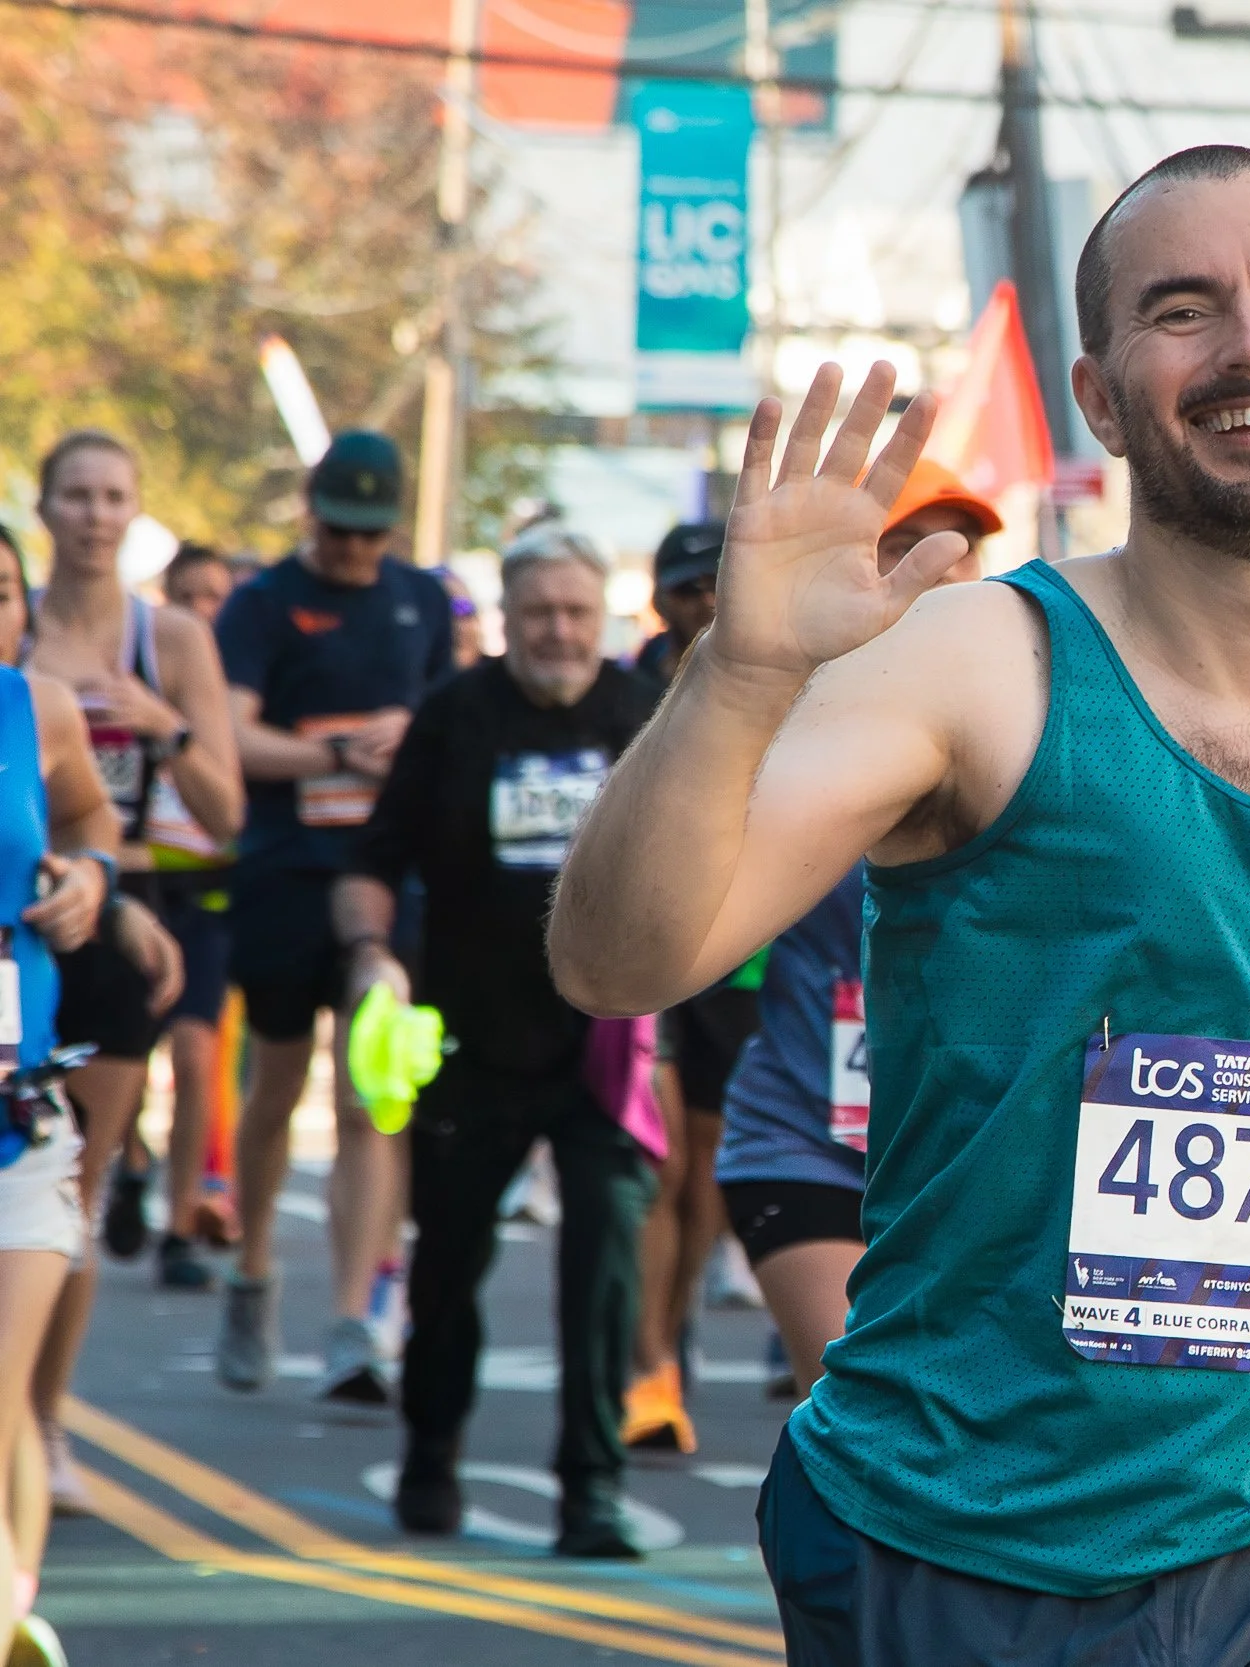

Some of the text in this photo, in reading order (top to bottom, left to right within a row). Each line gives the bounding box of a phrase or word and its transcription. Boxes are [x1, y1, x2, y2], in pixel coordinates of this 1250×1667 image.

[1131, 1047, 1205, 1099] tcs
[1070, 1305, 1141, 1327] WAVE 4
[1152, 1313, 1193, 1328] BLUE
[1109, 1342, 1118, 1350] M
[1200, 1345, 1236, 1358] FERRY
